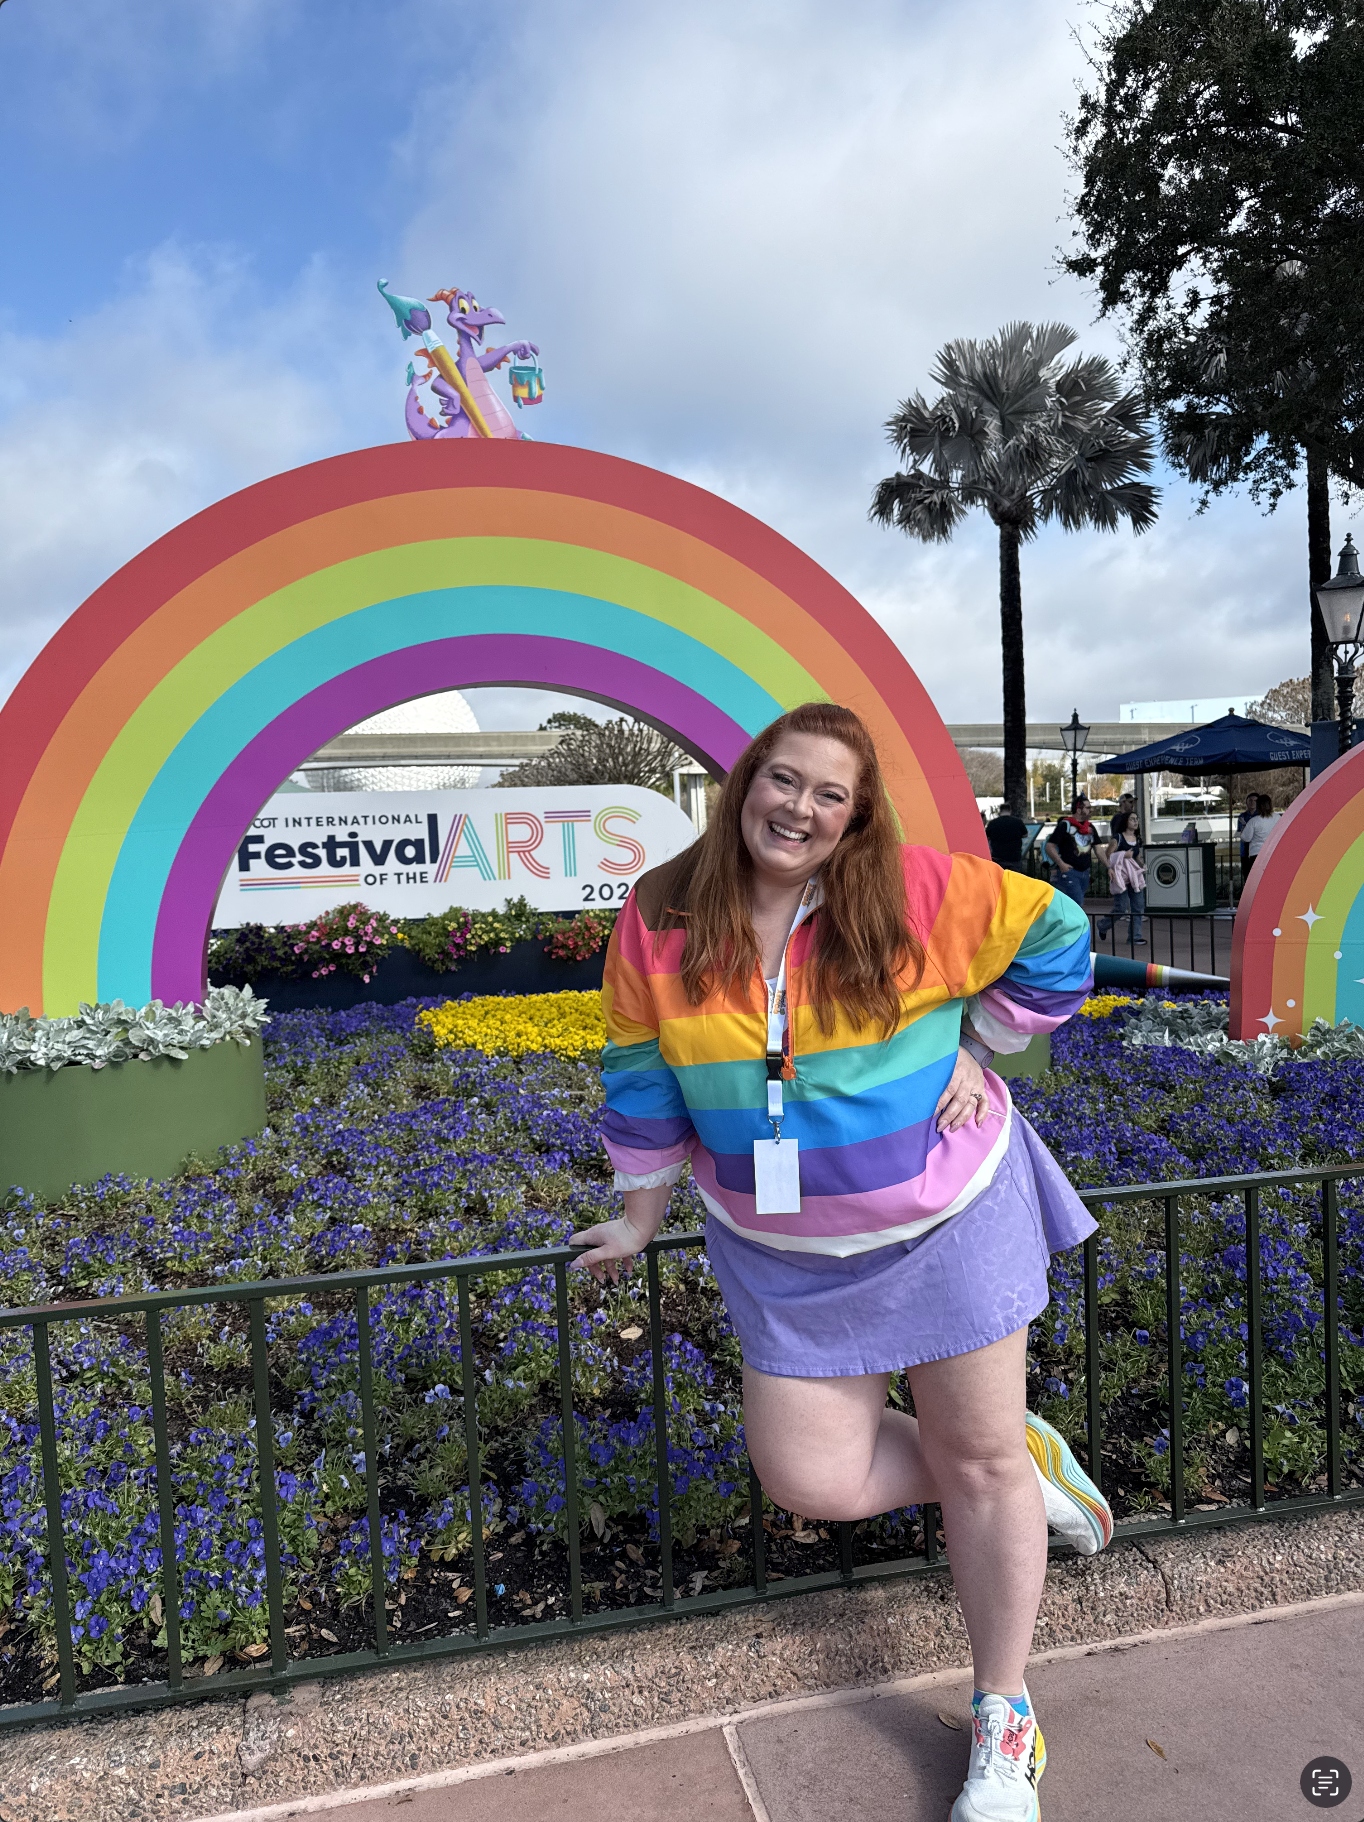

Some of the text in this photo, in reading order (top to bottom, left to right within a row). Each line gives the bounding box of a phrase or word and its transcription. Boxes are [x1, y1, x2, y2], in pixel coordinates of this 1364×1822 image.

[1269, 750, 1290, 761] GUEST
[1125, 760, 1143, 771] GUEST
[284, 813, 423, 828] INTERNATIONAL
[237, 813, 440, 872] Festival
[433, 806, 646, 883] ARTS
[364, 871, 429, 886] OF THE
